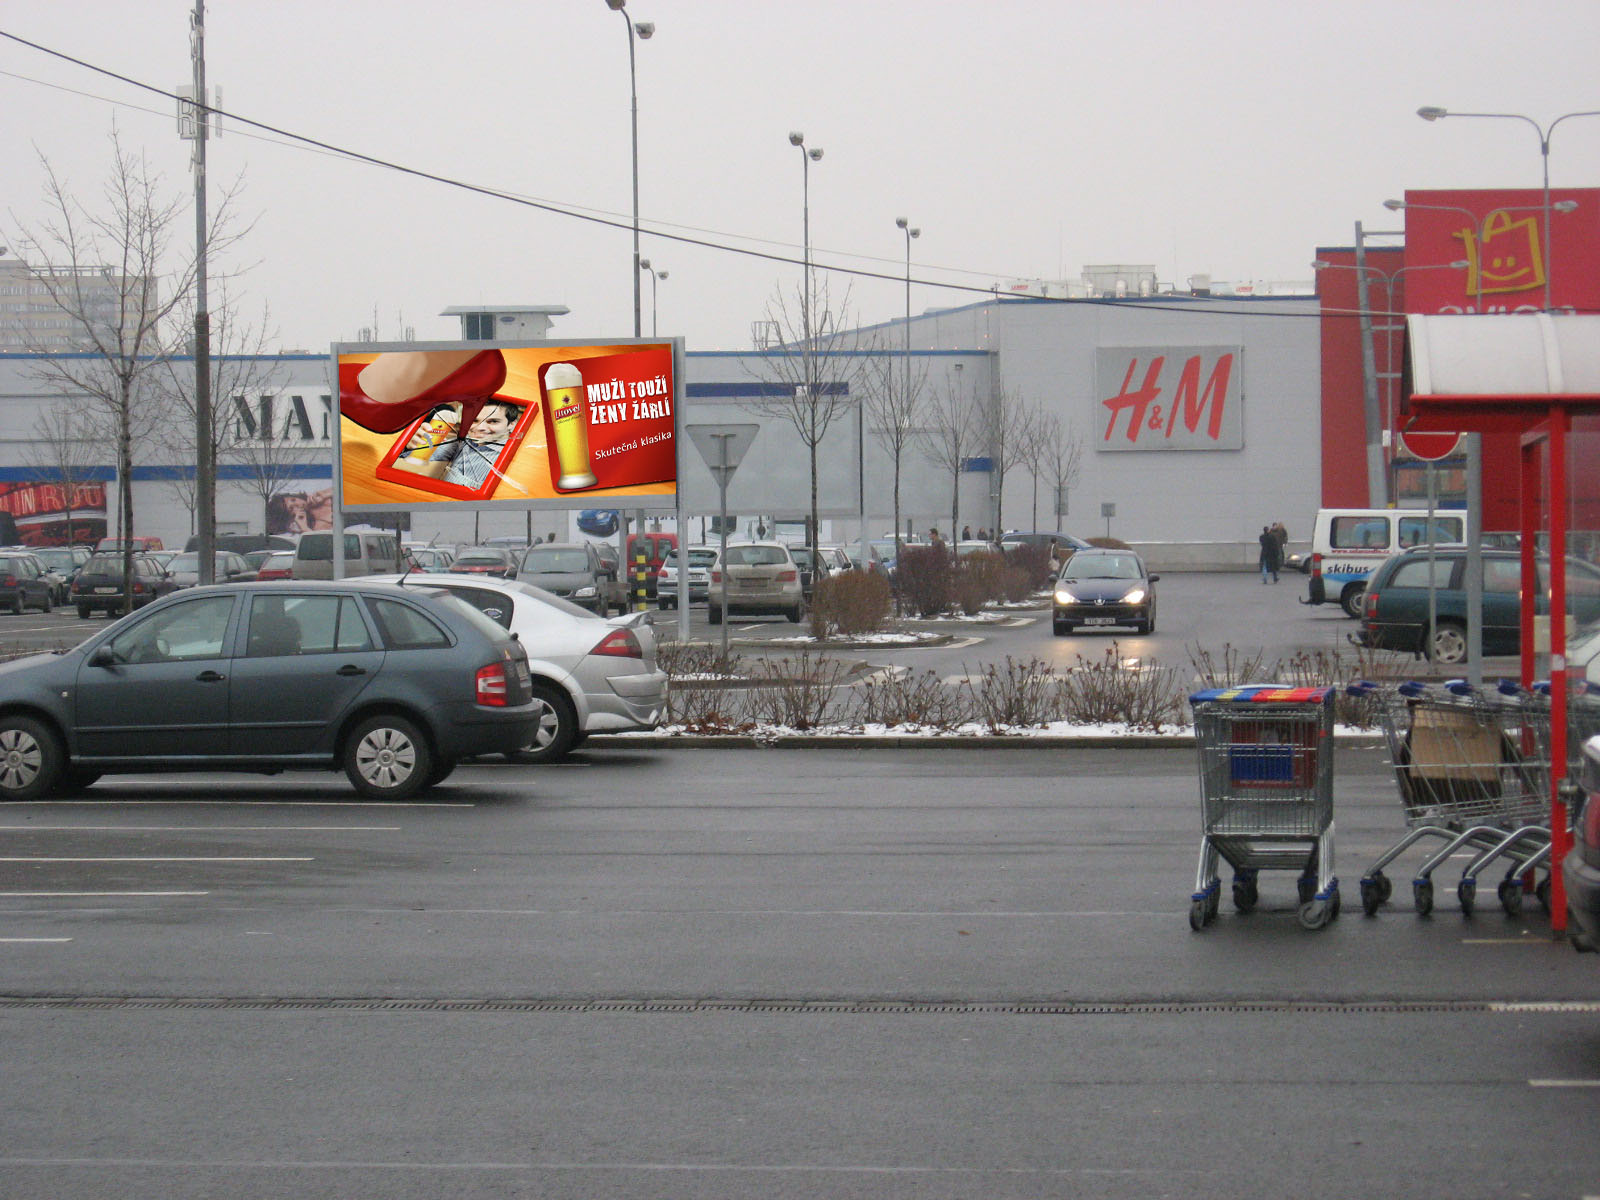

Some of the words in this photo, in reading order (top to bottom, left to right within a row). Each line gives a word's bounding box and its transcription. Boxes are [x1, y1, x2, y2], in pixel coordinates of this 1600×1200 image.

[587, 378, 626, 403] MUŽI
[628, 374, 668, 399] TOUŽÍ
[1102, 353, 1233, 443] H&M
[589, 403, 628, 425] ŽENY
[632, 397, 671, 420] ŽÁRLÍ
[595, 440, 638, 460] Skutečná
[640, 431, 672, 447] klasika
[1327, 563, 1370, 574] skibus
